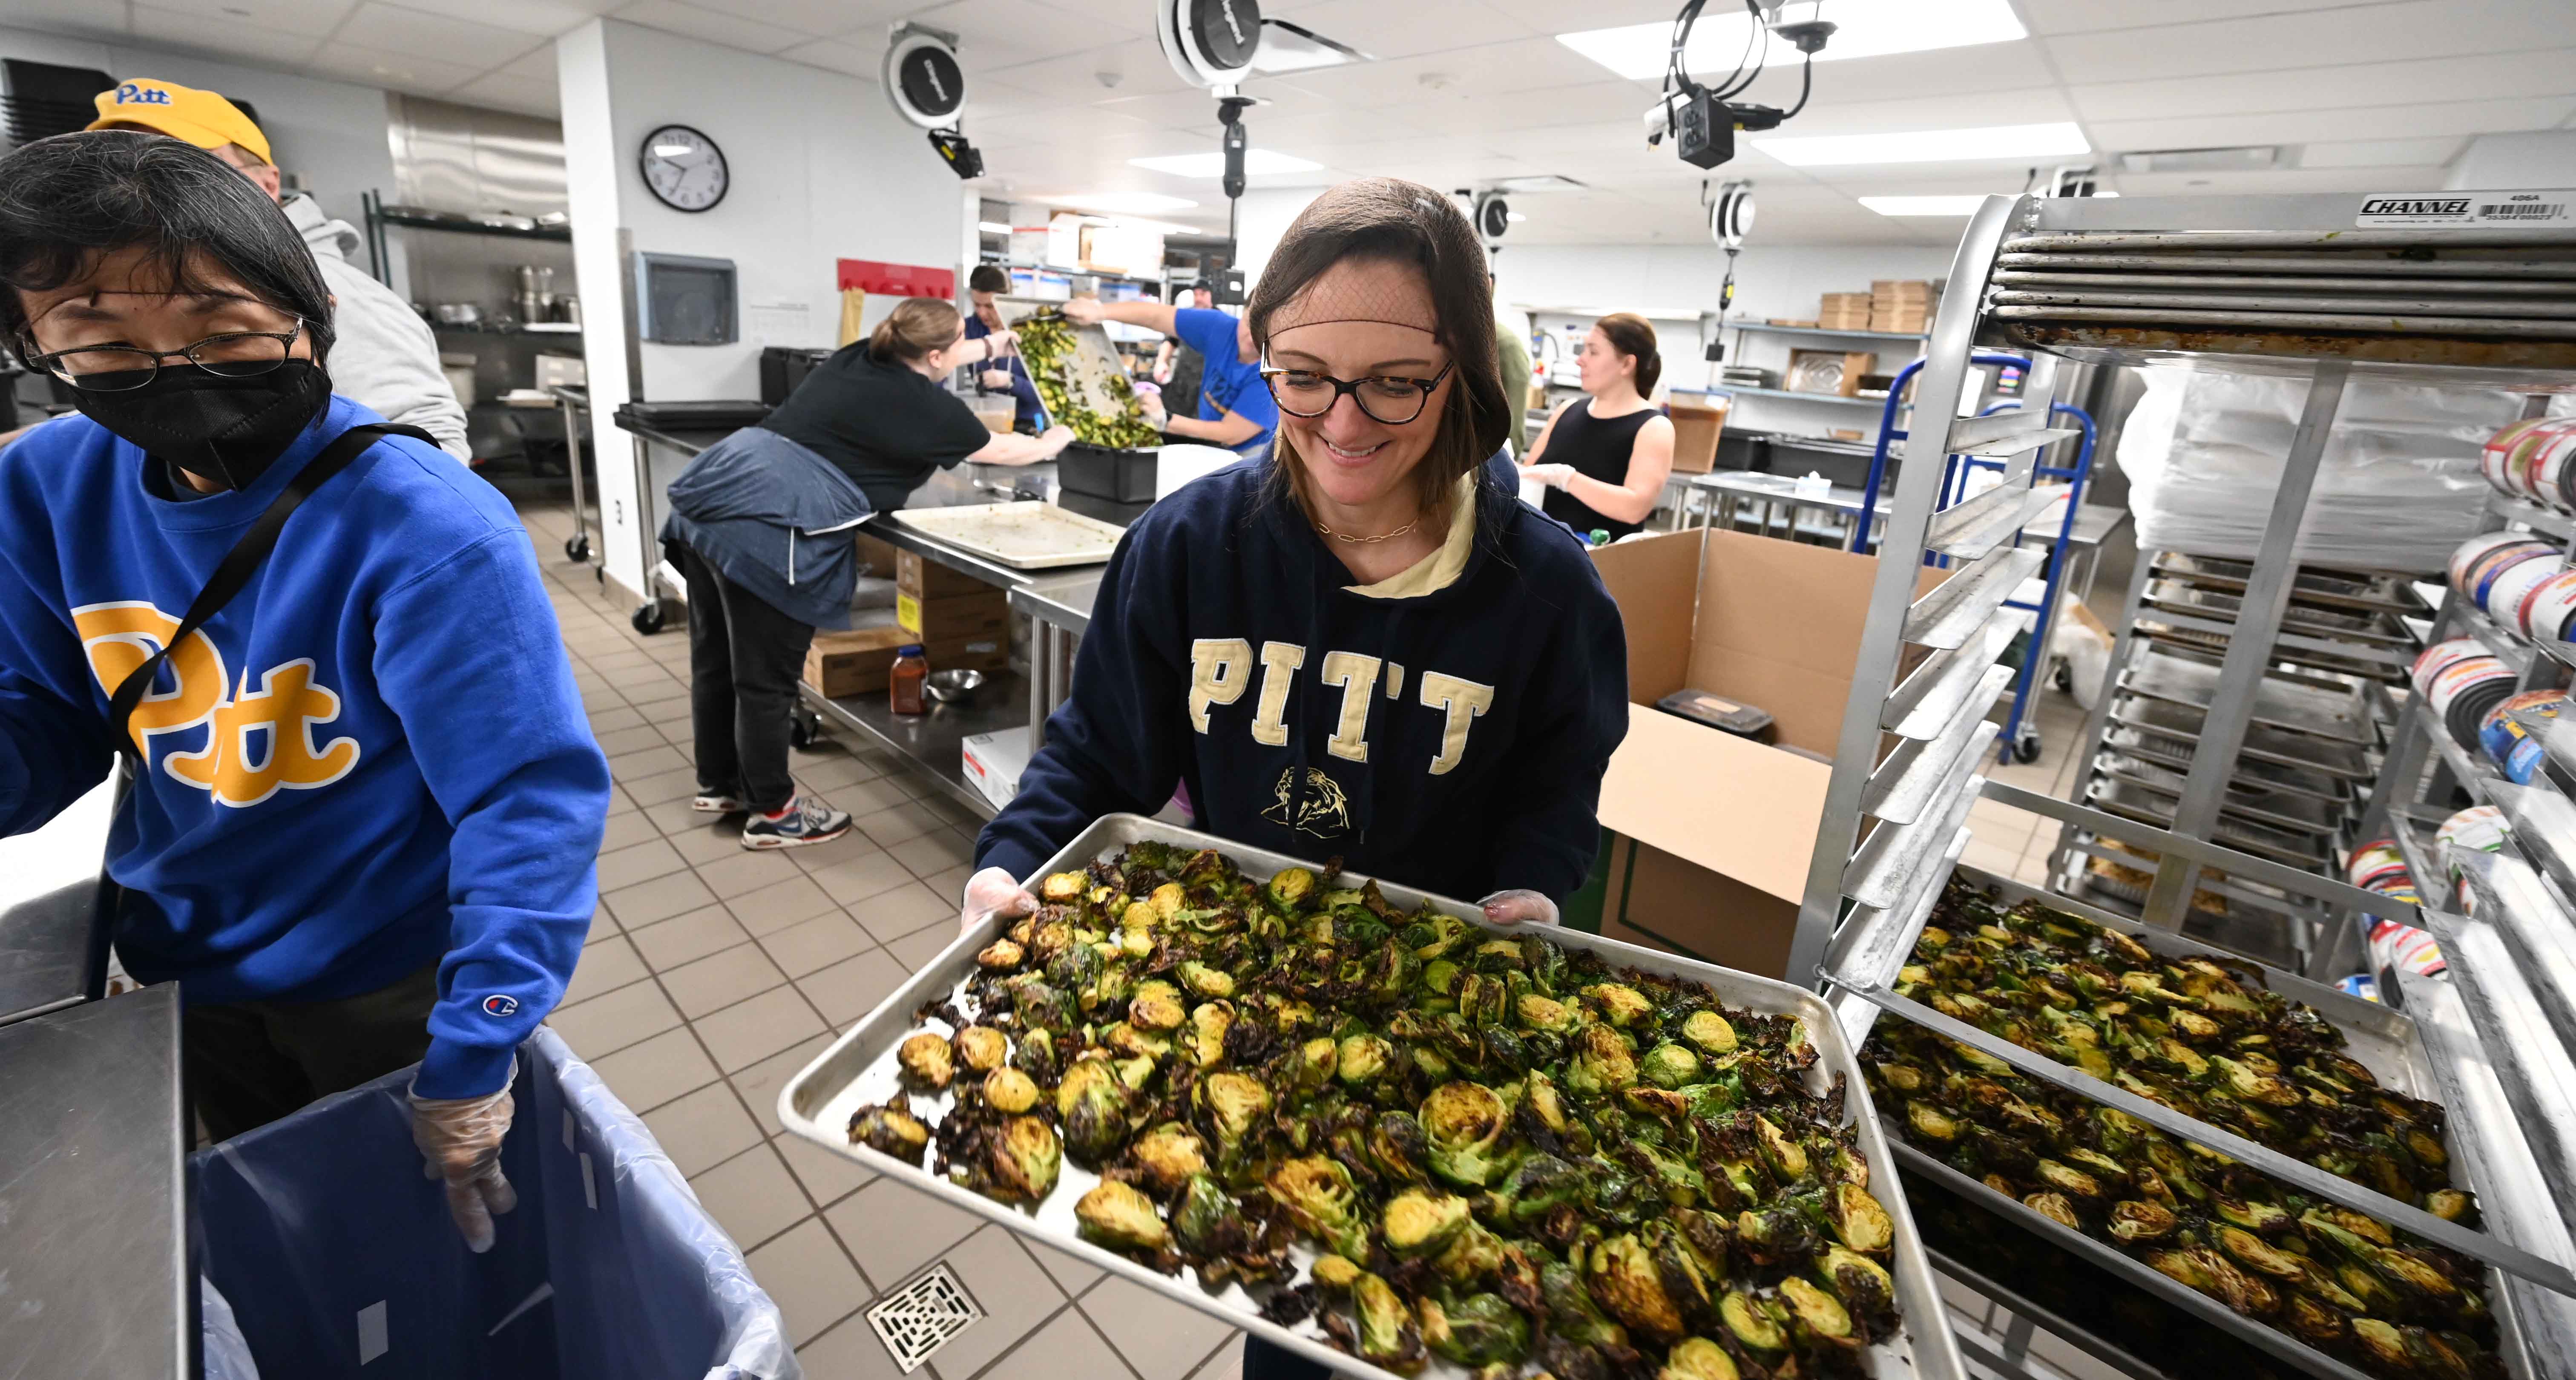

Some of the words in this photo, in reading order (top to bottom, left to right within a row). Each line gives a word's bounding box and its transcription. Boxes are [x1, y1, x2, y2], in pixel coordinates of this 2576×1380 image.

[117, 84, 170, 104] Pitt
[678, 134, 690, 145] 12
[2361, 199, 2470, 213] CHANNEL
[71, 600, 360, 808] Pitt
[1189, 637, 1495, 775] PITT
